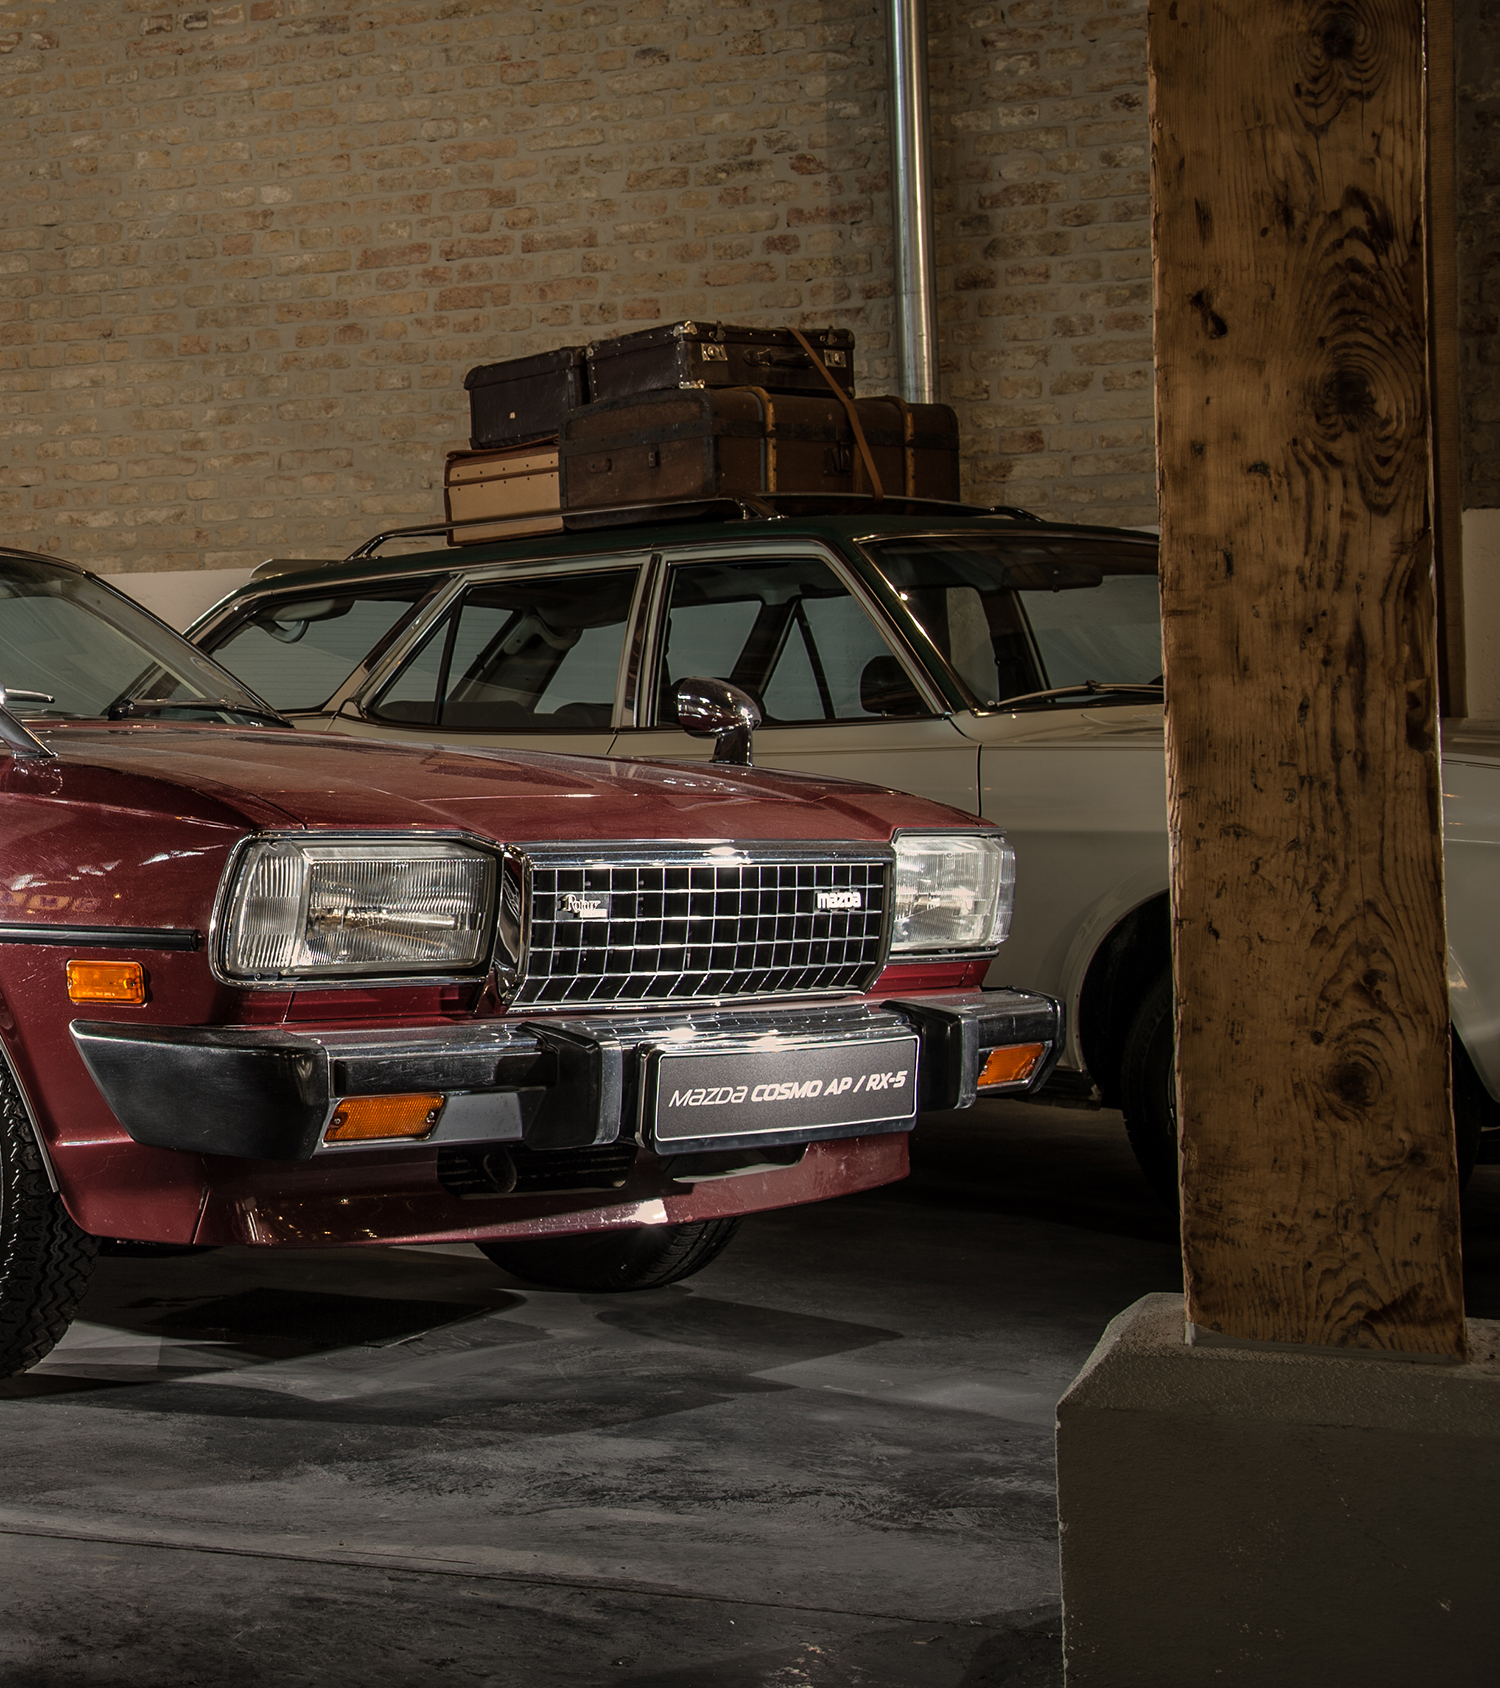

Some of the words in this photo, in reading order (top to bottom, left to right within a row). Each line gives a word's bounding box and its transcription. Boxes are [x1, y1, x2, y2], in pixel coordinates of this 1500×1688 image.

[817, 891, 861, 909] mazda
[751, 1080, 823, 1102] COSMO
[823, 1076, 853, 1097] AP
[853, 1076, 866, 1093] /
[866, 1070, 908, 1091] RX-5
